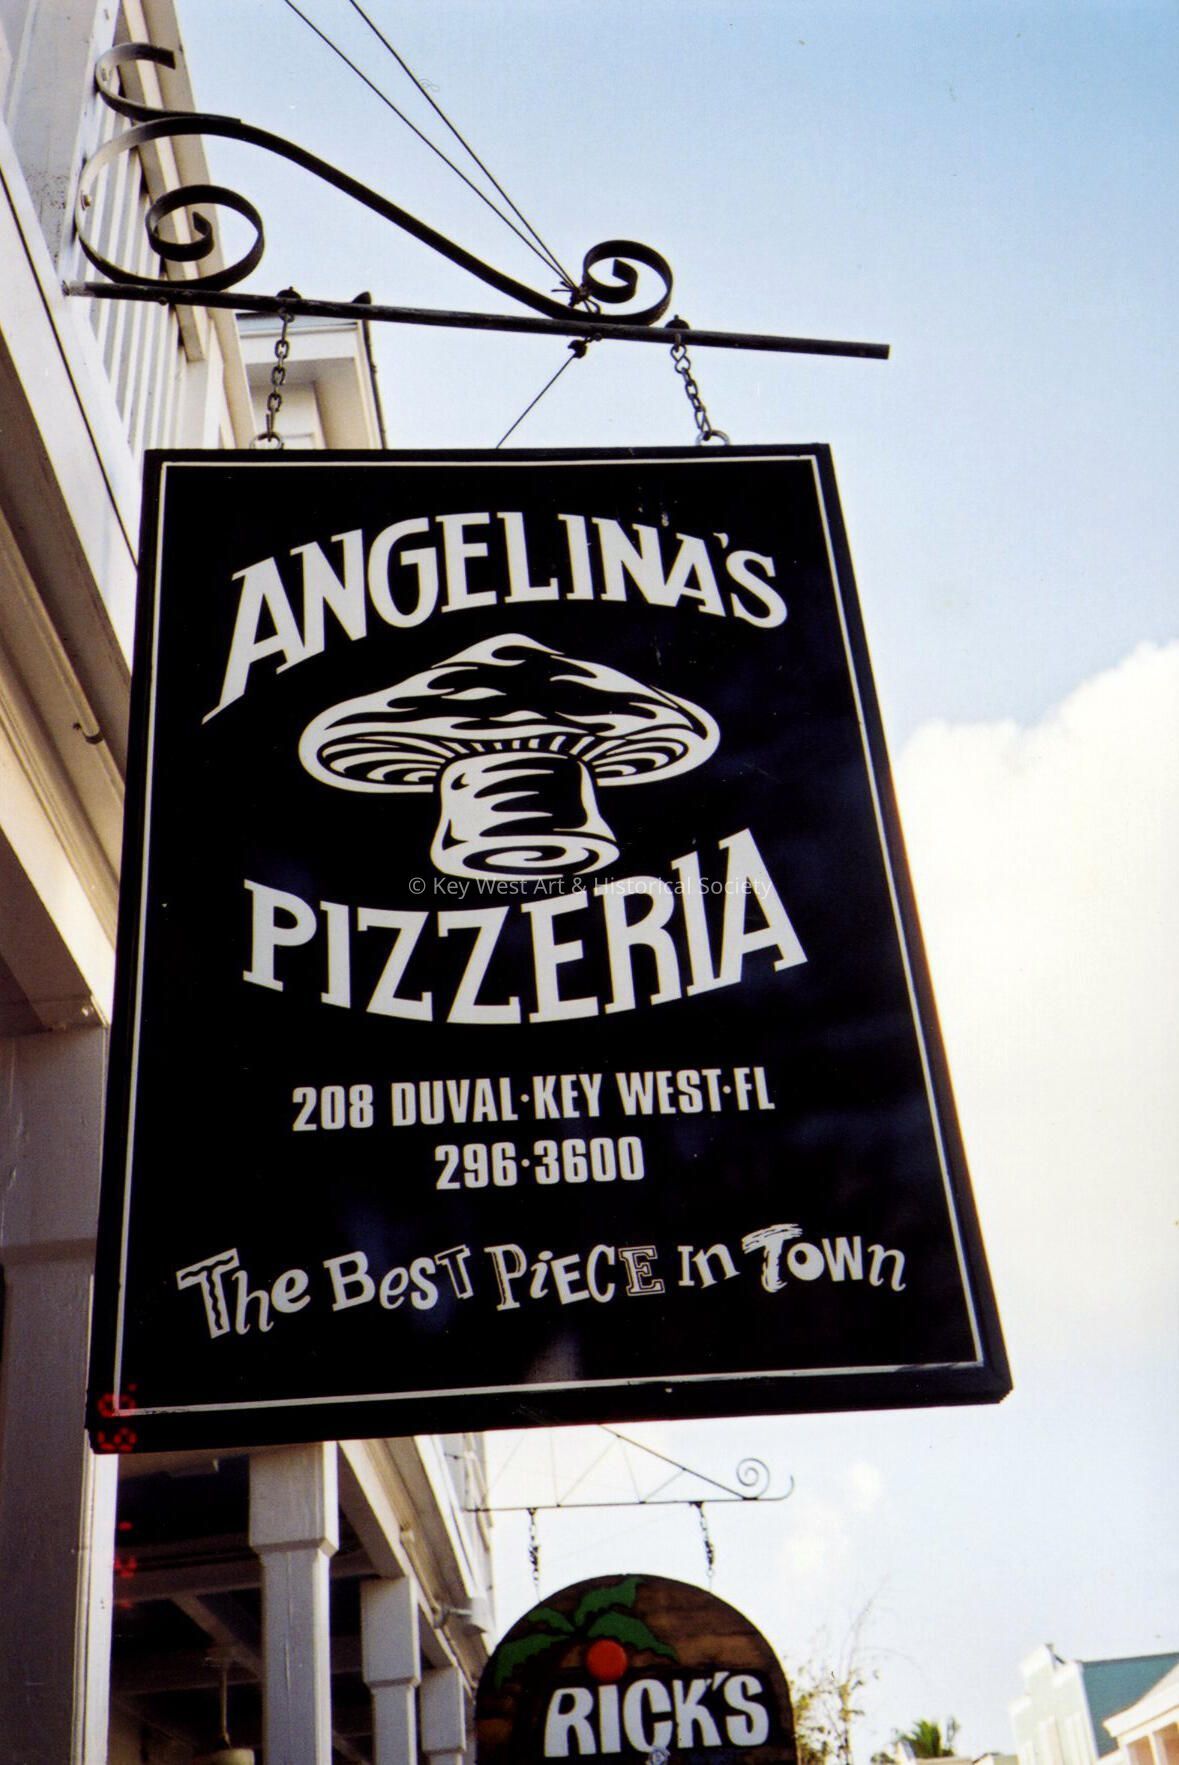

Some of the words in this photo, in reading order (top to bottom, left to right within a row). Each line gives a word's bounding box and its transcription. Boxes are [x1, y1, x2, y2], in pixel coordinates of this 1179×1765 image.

[202, 511, 788, 725] ANGELINA'S
[243, 827, 808, 1025] PIZZERIA
[292, 1083, 374, 1131] 208
[176, 1248, 311, 1339] The
[677, 1243, 740, 1289] In
[544, 1671, 769, 1758] RICK'S
